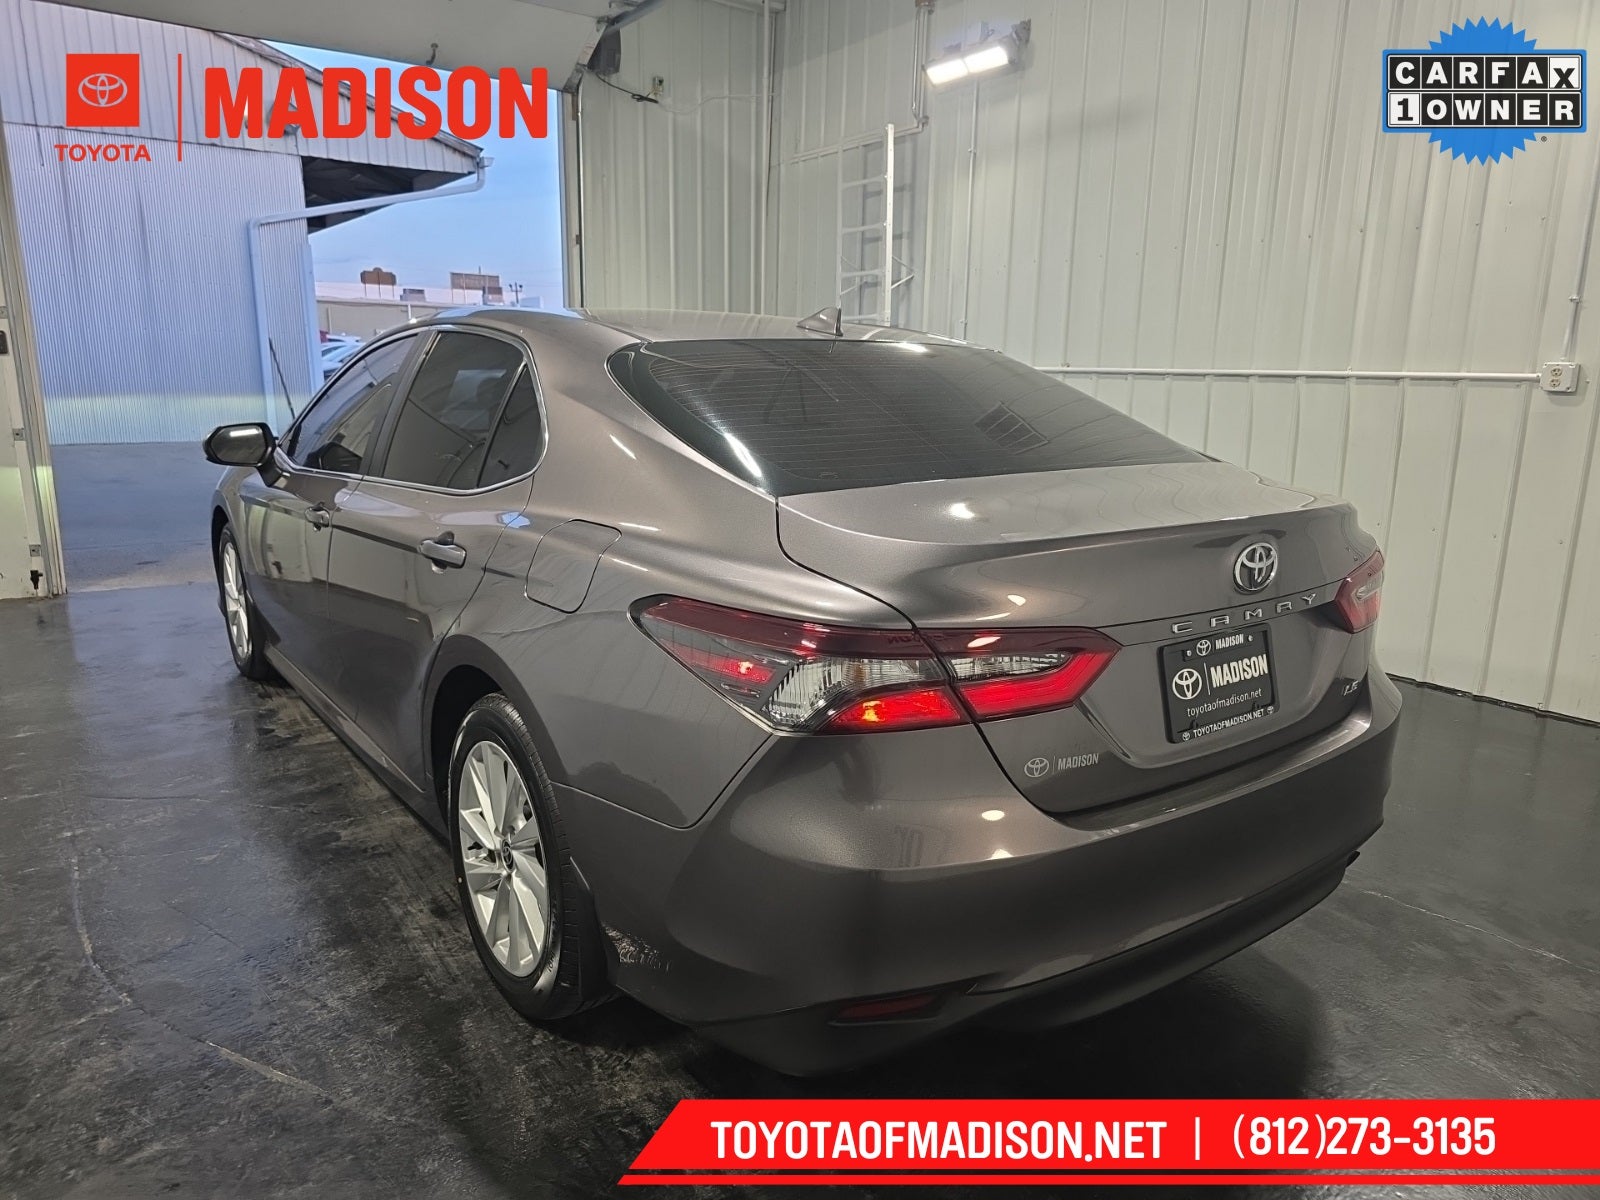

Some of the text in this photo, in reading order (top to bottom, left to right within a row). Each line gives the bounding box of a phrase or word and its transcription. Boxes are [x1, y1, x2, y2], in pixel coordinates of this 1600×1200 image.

[1171, 593, 1317, 634] CAMRY
[1215, 633, 1244, 650] MADISON
[1210, 653, 1269, 688] MADISON
[1187, 687, 1262, 718] toyotaofmadison.net
[1193, 708, 1265, 738] TOYOTAOFMADISON.NET
[1057, 753, 1100, 771] MADISON
